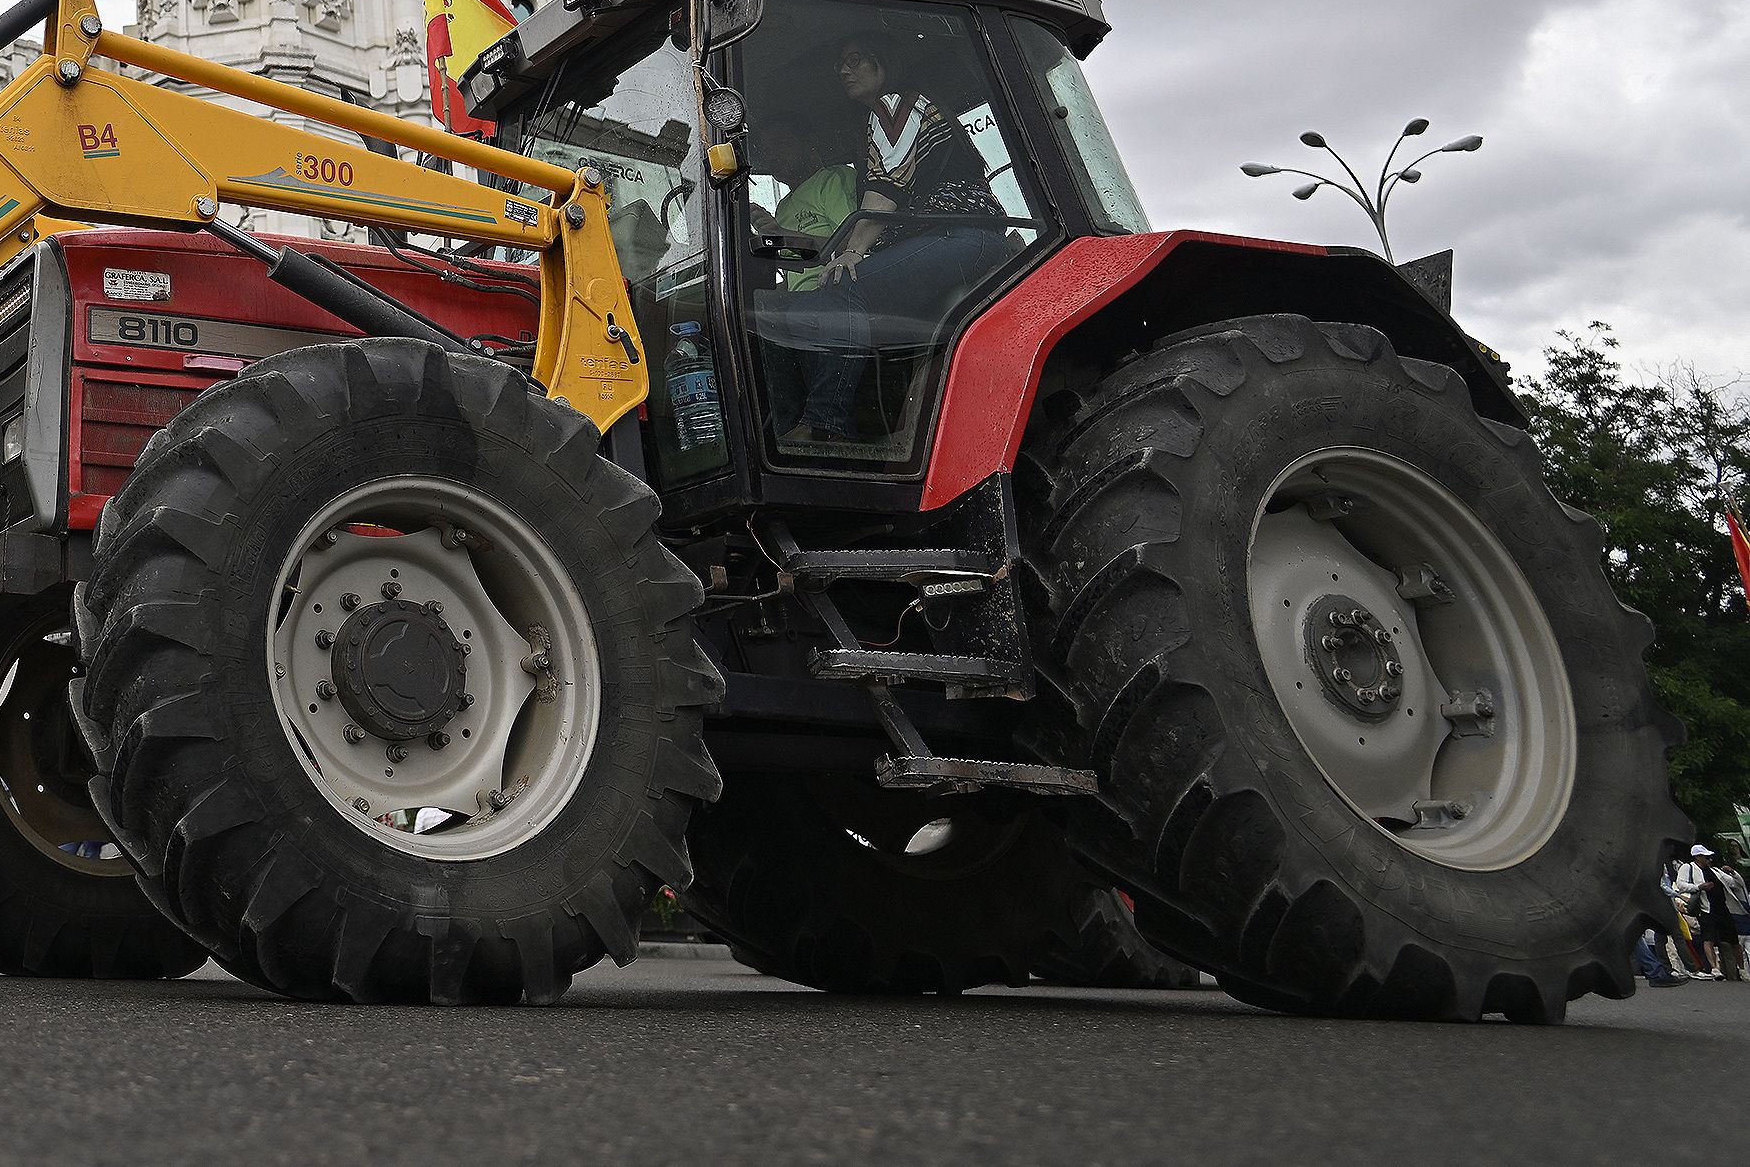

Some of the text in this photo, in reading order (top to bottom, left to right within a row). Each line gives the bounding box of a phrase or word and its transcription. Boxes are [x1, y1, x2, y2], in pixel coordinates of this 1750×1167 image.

[78, 123, 118, 151] B4
[295, 152, 303, 175] serie
[303, 154, 354, 187] 300
[118, 316, 199, 346] 8110
